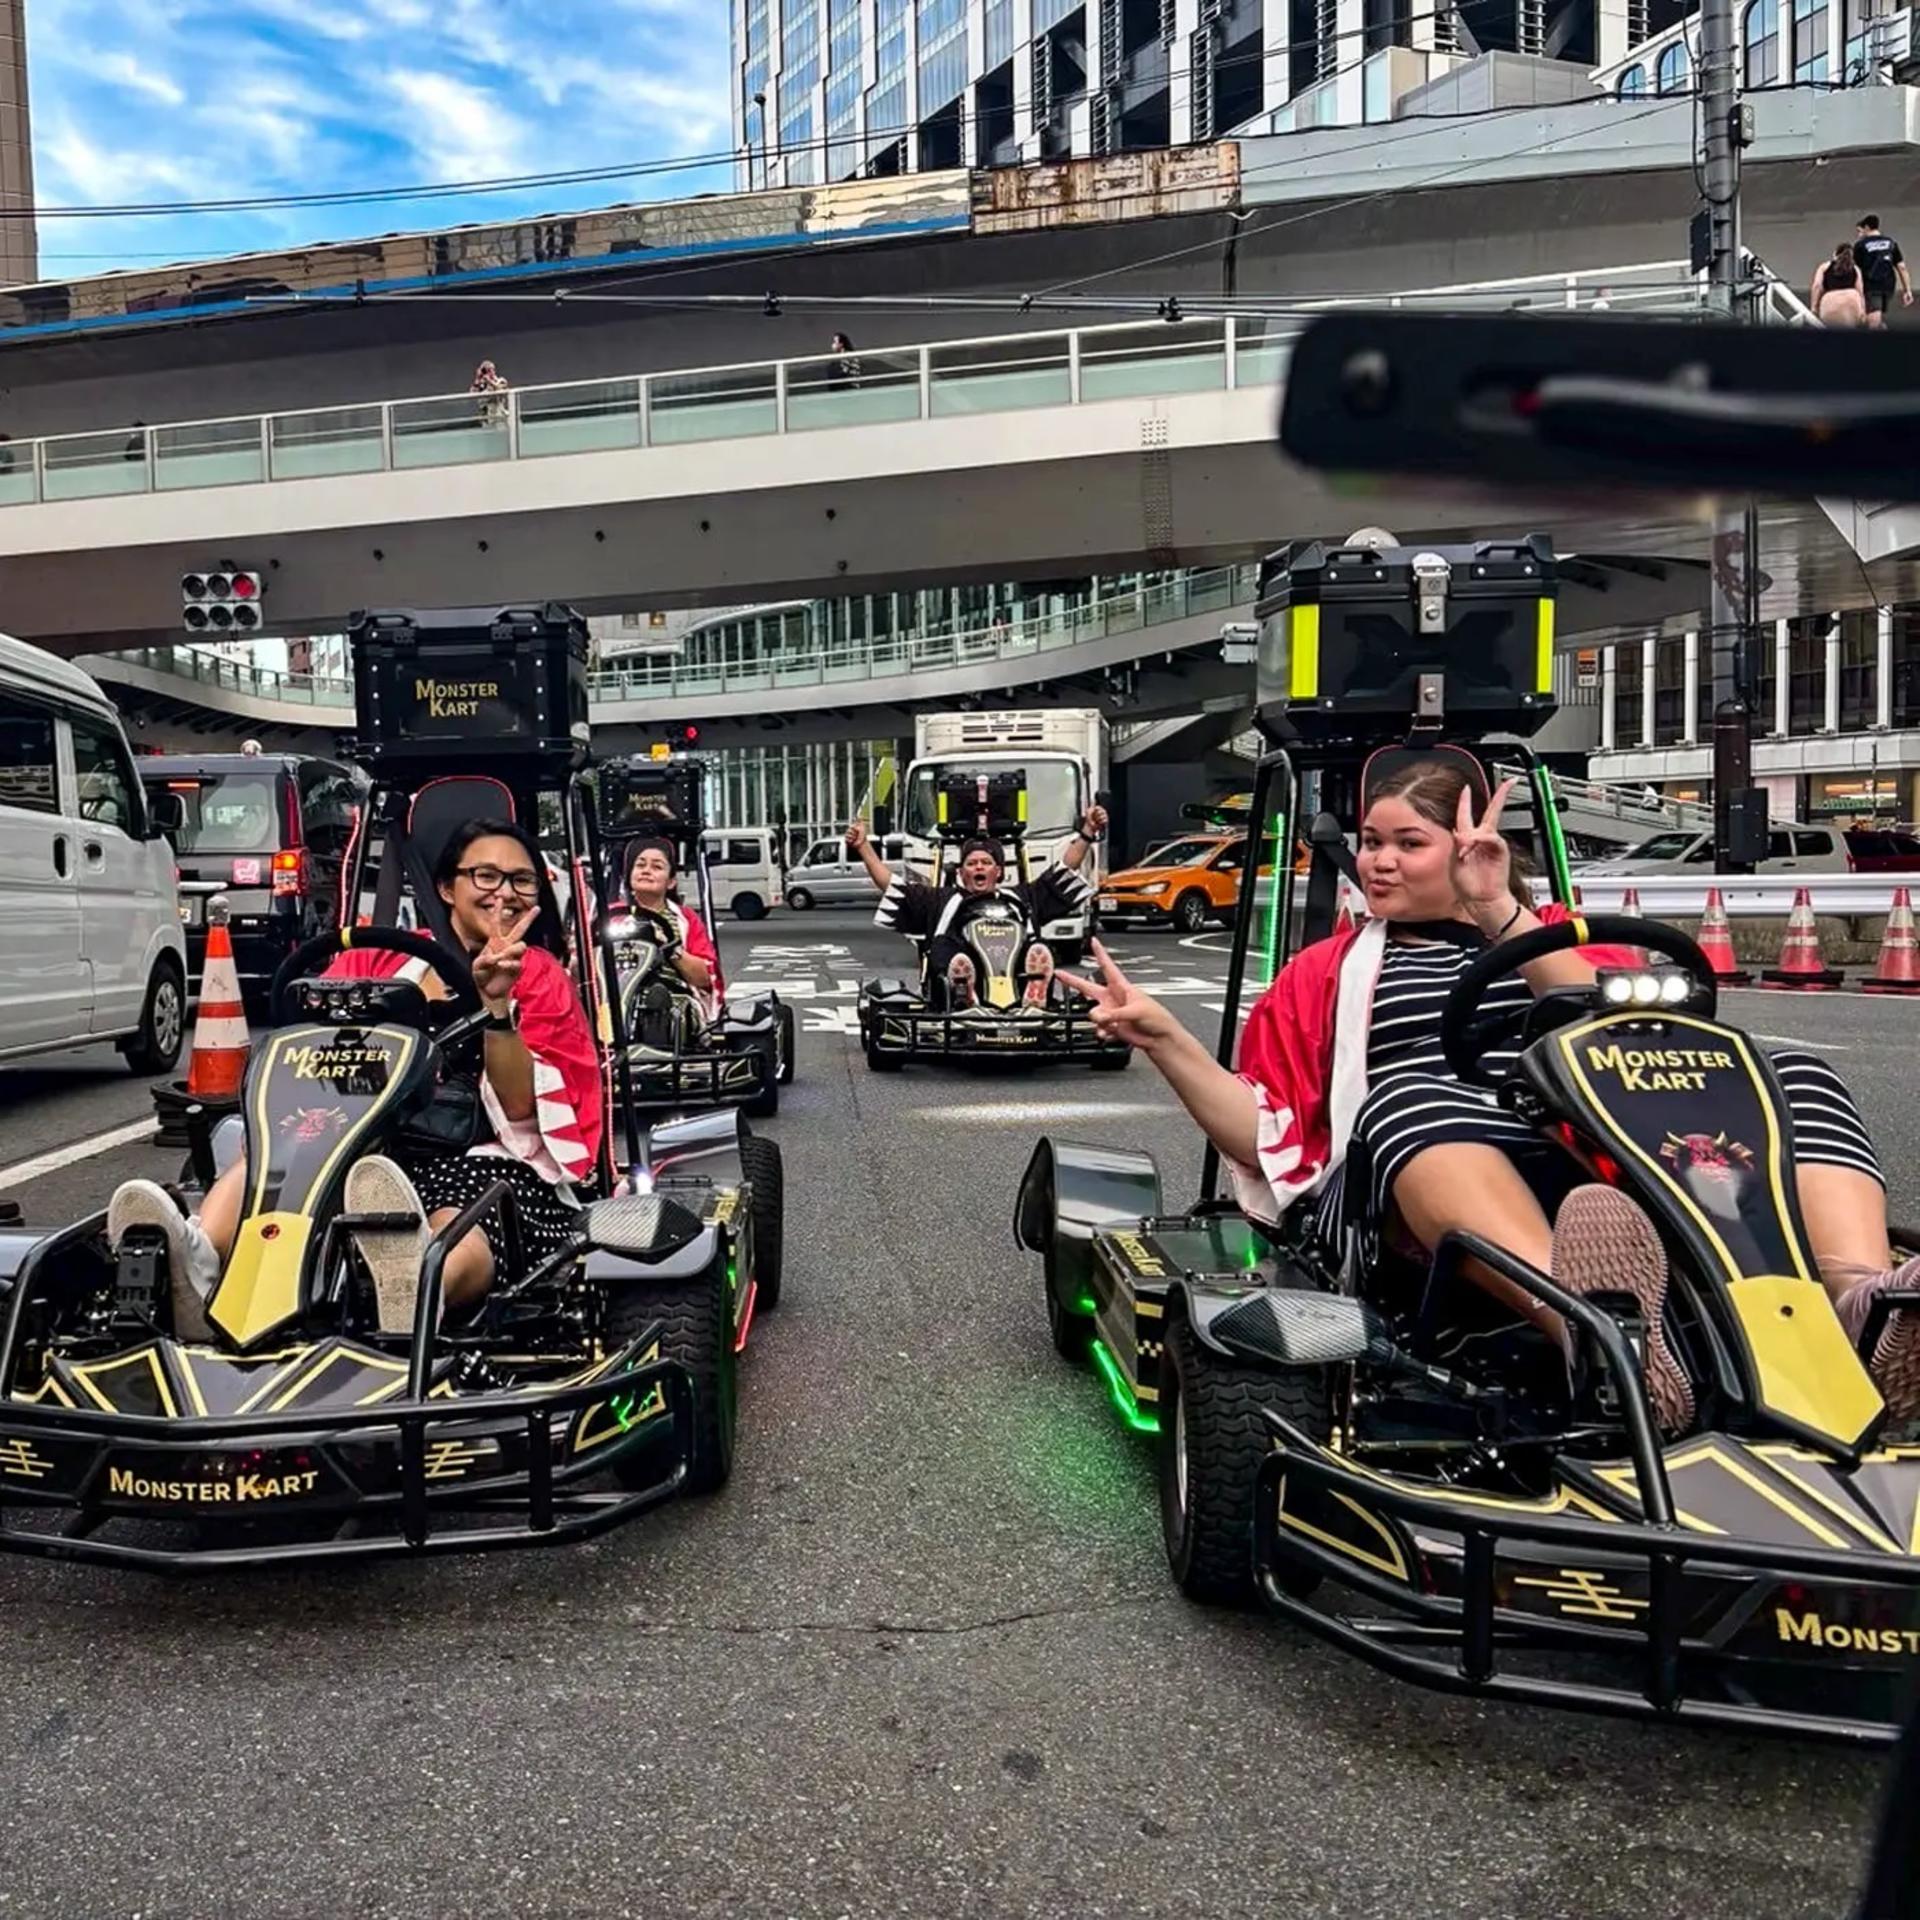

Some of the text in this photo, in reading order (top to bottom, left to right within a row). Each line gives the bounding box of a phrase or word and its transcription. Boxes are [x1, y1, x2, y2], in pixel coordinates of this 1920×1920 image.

[415, 679, 499, 700] MONSTER
[429, 698, 479, 717] KART
[282, 1045, 393, 1065] MONSTER
[1587, 1045, 1735, 1071] MONSTER
[294, 1060, 362, 1079] KART
[1620, 1068, 1706, 1091] KART
